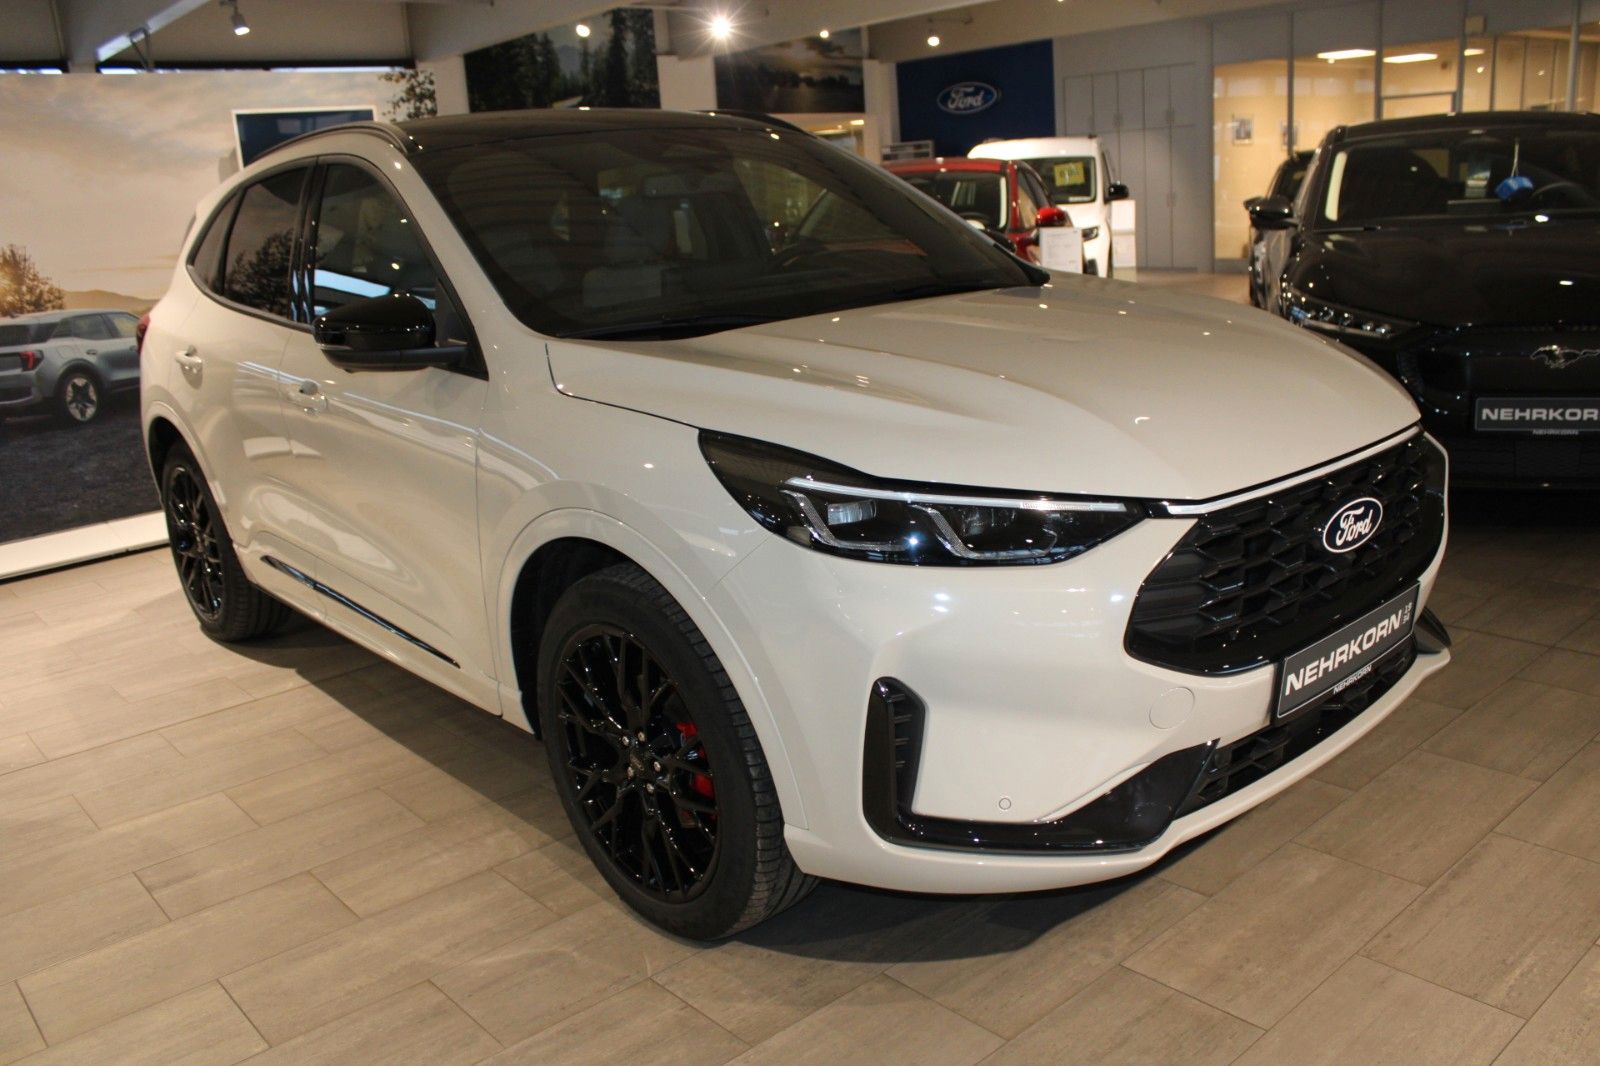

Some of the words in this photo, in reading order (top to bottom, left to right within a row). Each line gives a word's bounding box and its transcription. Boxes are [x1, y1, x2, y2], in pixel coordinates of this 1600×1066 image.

[947, 86, 984, 109] Ford
[1336, 507, 1373, 545] Ford
[1285, 609, 1401, 696] NEHRKORN
[1333, 664, 1372, 695] NEHRKORN
